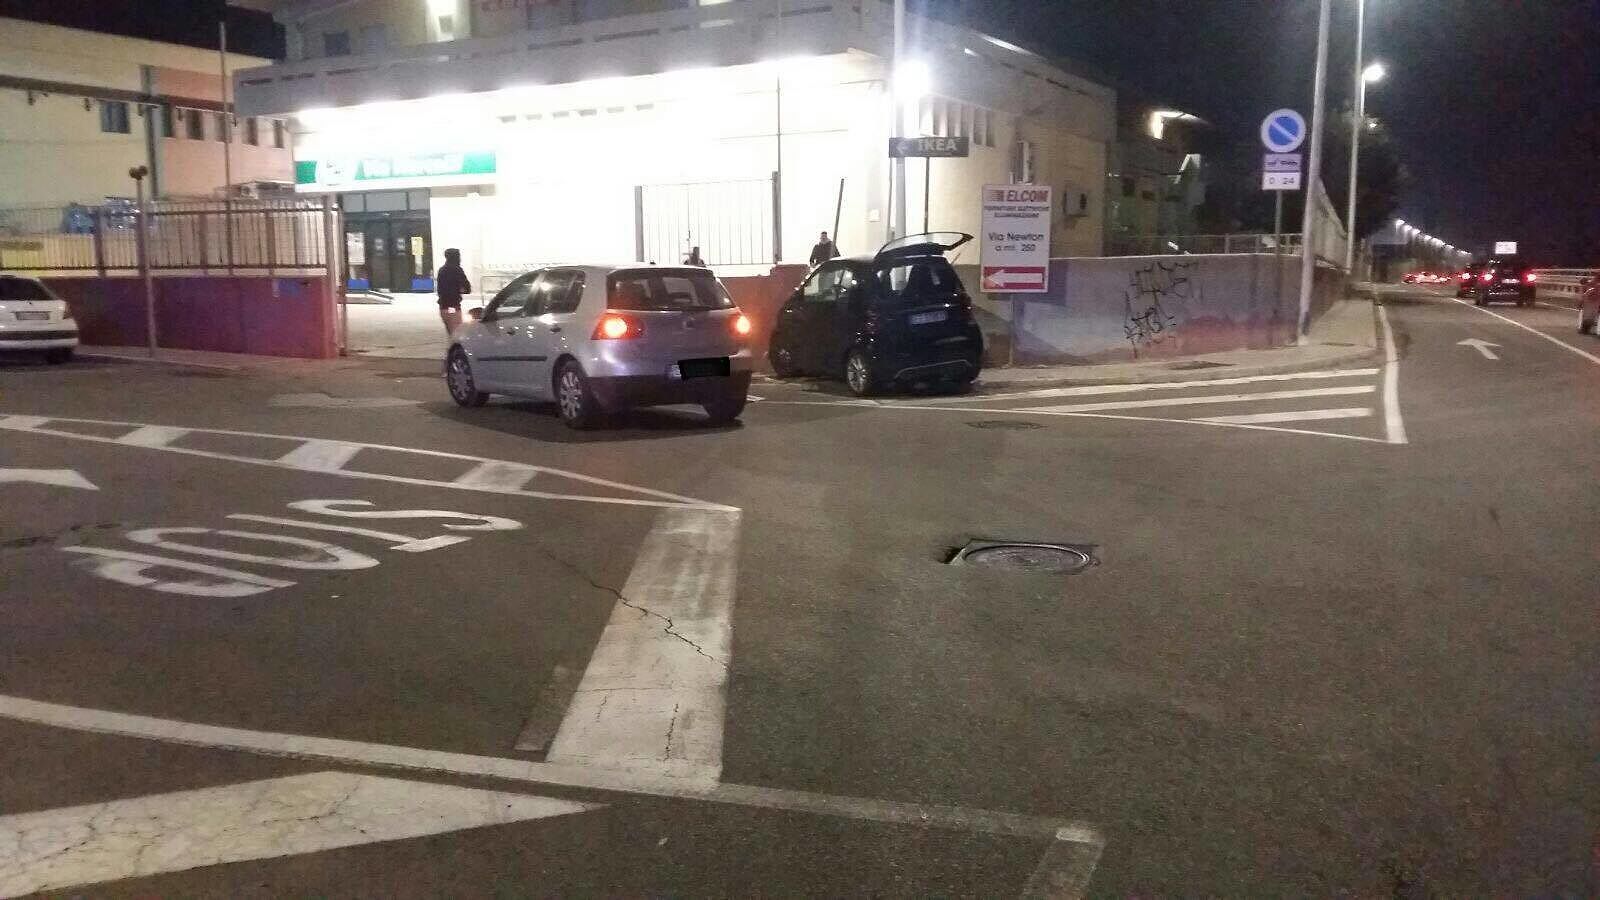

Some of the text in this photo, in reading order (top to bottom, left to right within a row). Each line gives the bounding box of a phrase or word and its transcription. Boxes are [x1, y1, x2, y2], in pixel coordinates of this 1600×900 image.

[1007, 190, 1048, 202] ELCOM
[988, 232, 1044, 241] Via Newton
[60, 499, 523, 597] STOP
